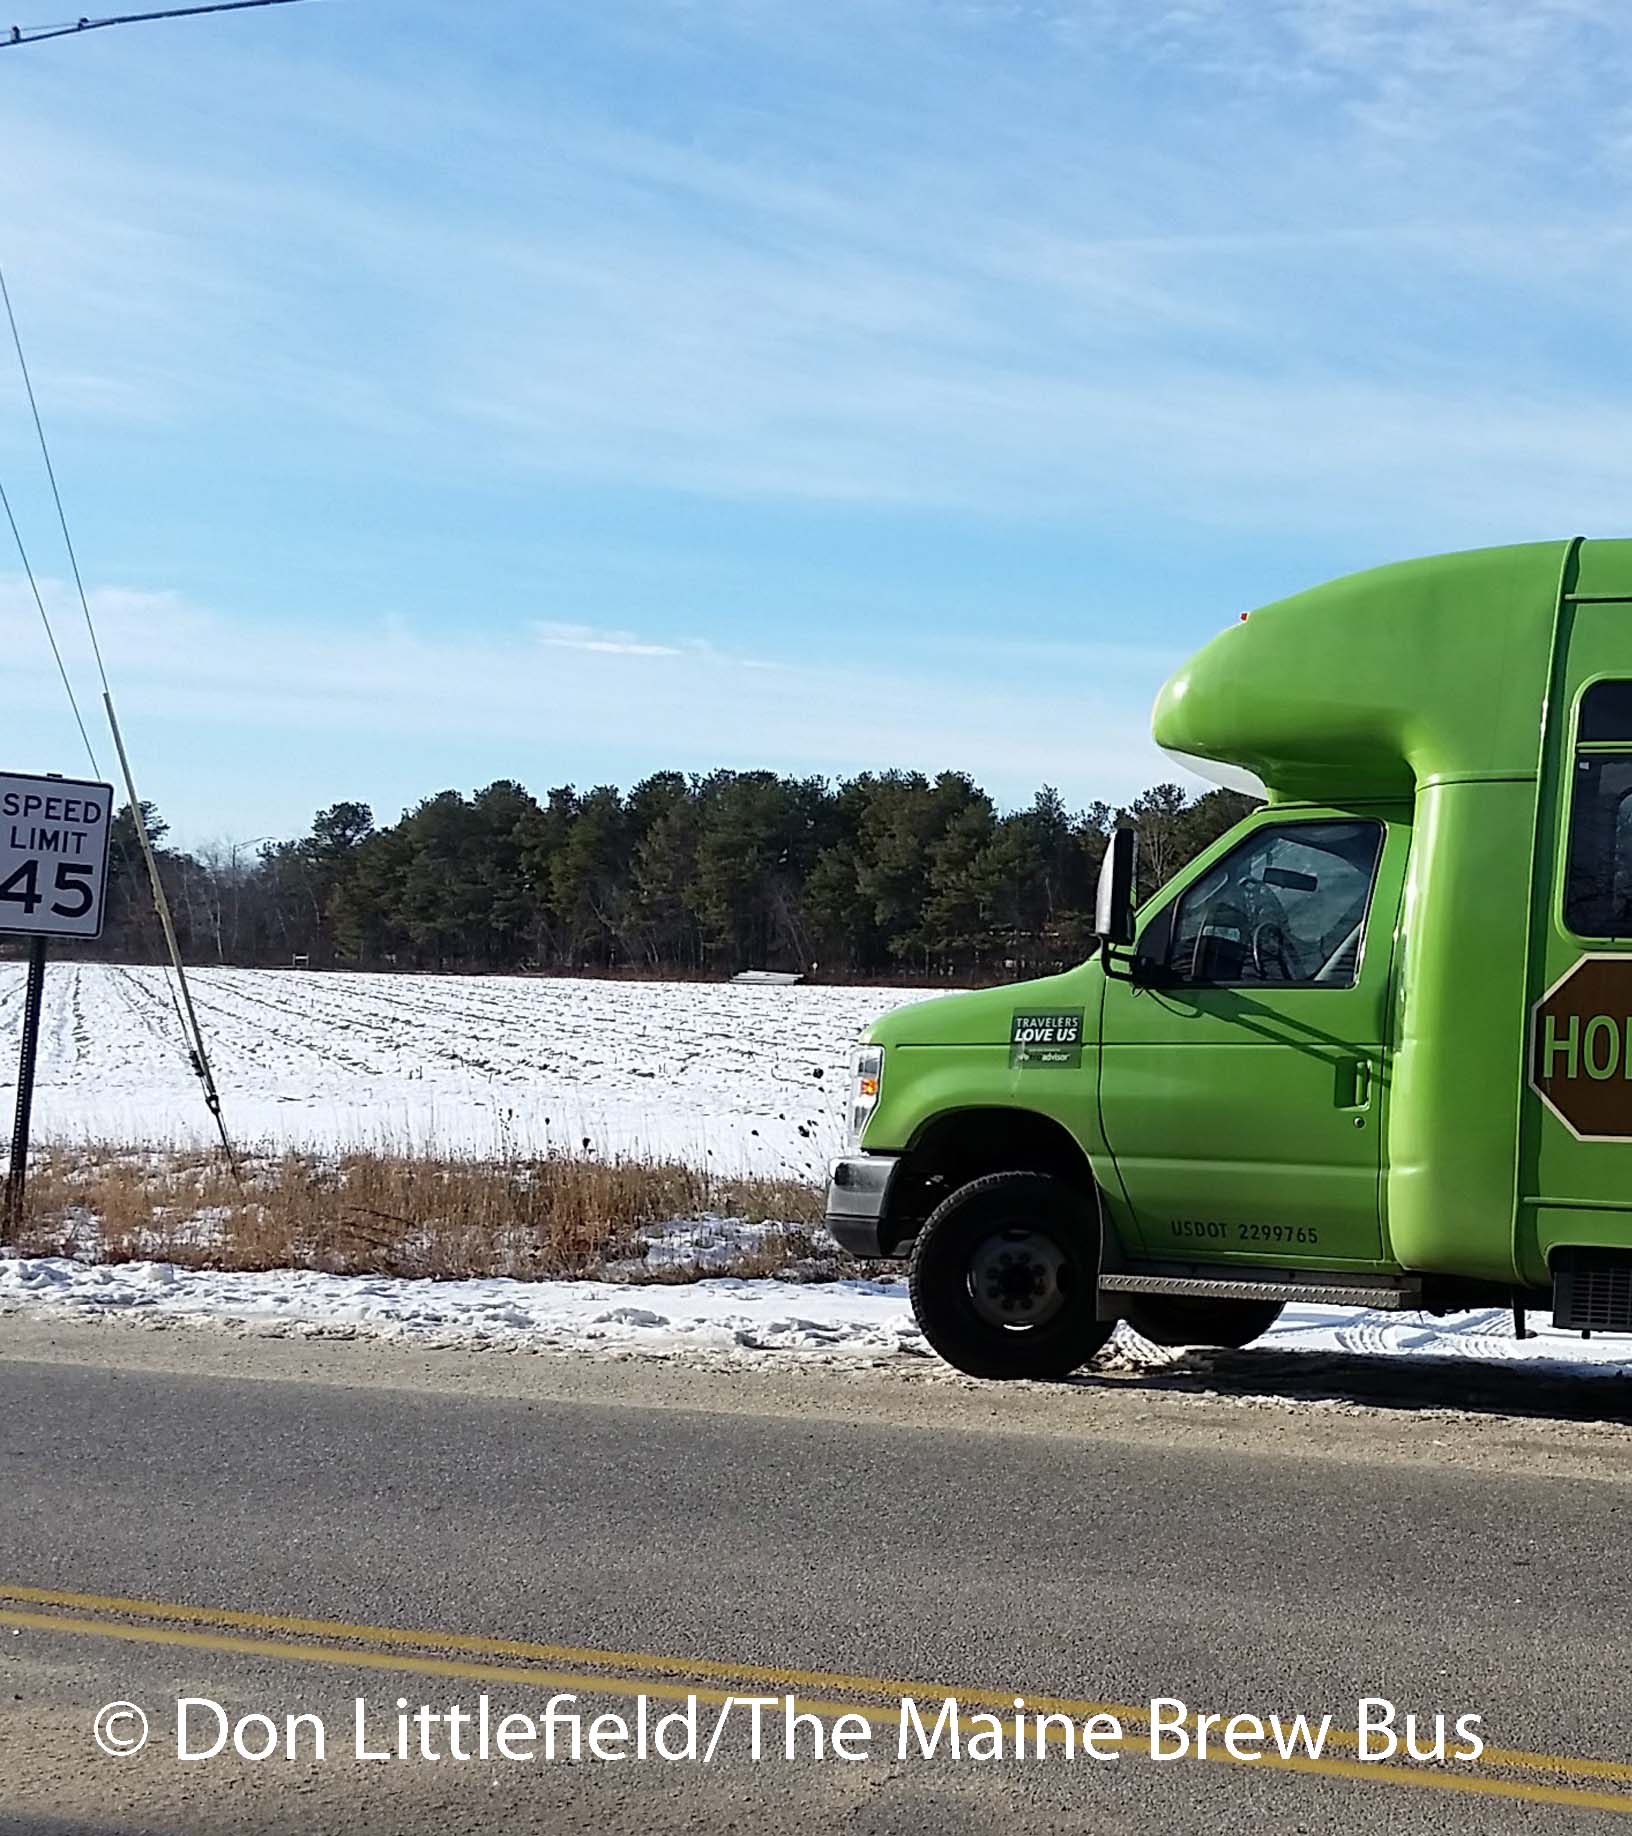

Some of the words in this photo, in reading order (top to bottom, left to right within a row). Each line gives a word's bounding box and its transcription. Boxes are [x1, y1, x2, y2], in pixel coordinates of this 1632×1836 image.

[2, 792, 101, 824] SPEED
[10, 825, 88, 854] LIMIT
[0, 858, 94, 918] 45
[1014, 1028, 1054, 1042] LOVE
[1056, 1028, 1078, 1042] US
[1016, 1016, 1078, 1028] TRAVELERS
[1171, 1220, 1228, 1239] USDOT
[1237, 1223, 1319, 1245] 2299765
